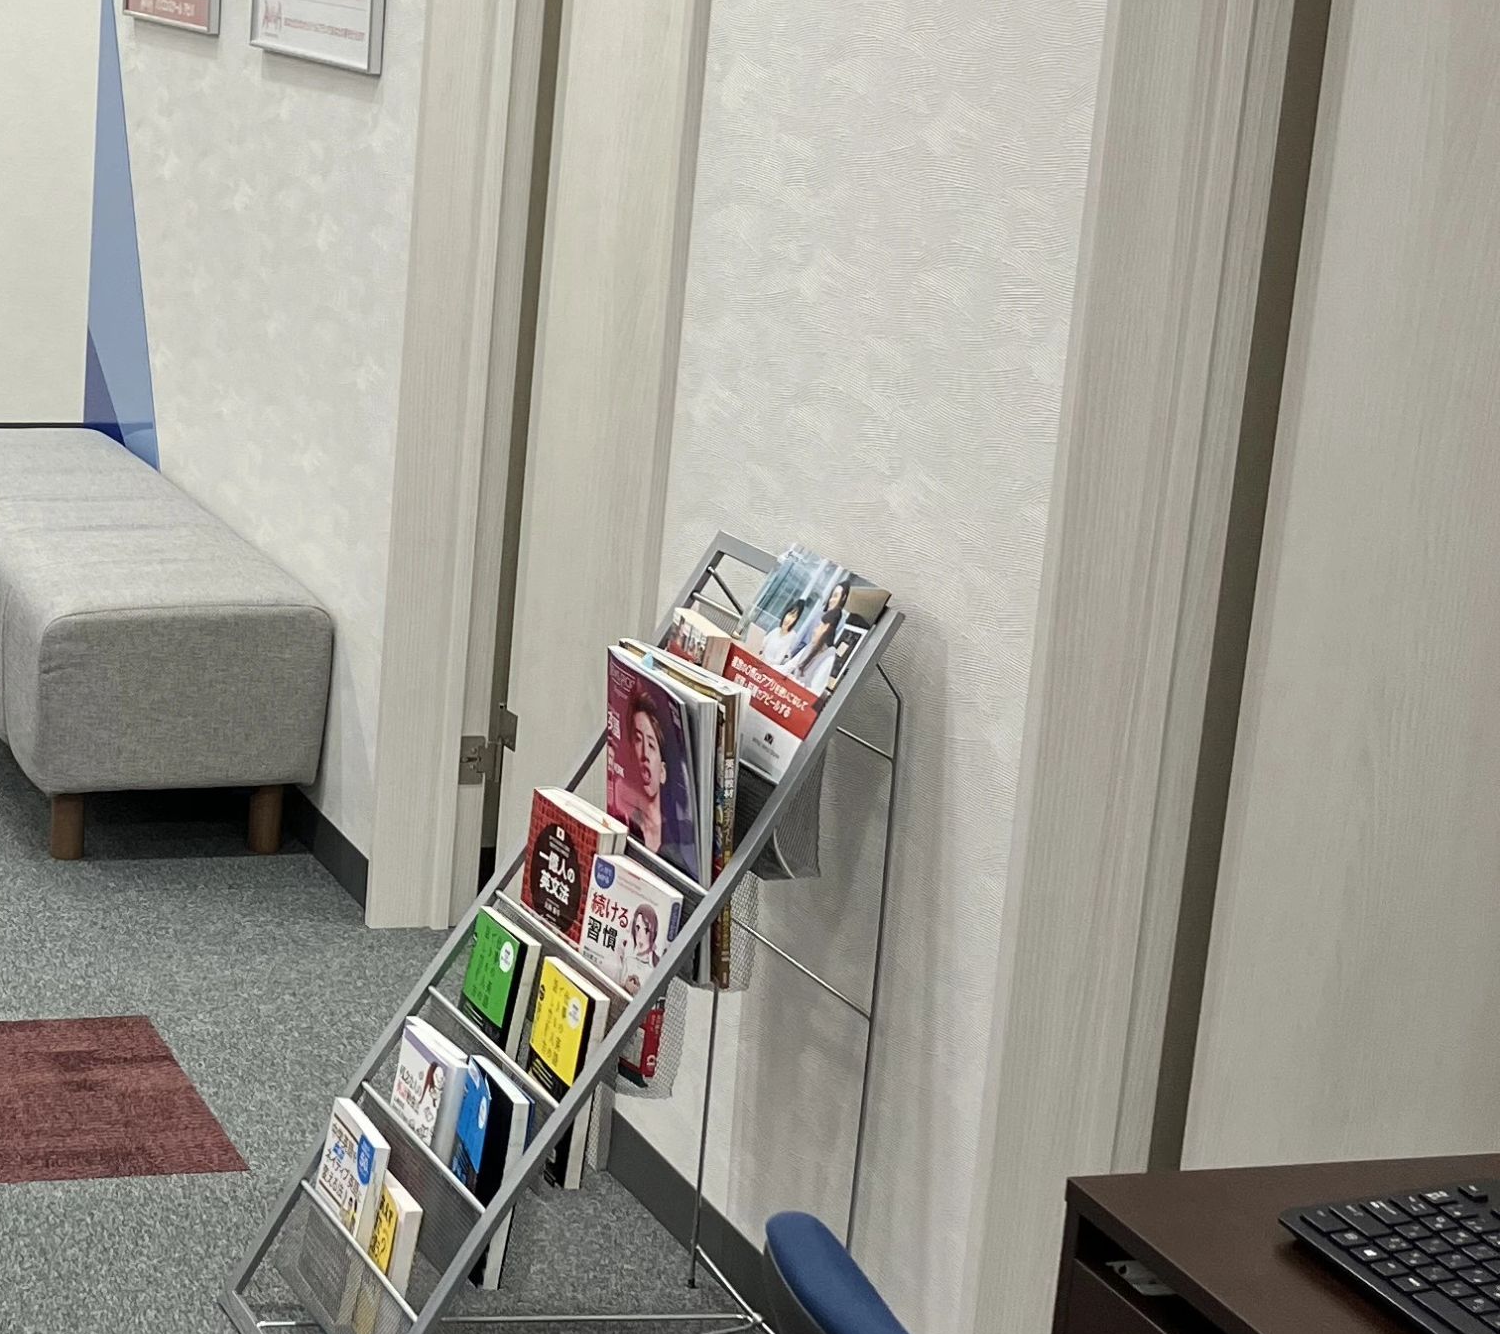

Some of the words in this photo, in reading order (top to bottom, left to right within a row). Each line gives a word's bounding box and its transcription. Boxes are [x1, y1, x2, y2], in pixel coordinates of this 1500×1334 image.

[591, 892, 629, 929] 続ける
[587, 915, 618, 952] 習慣
